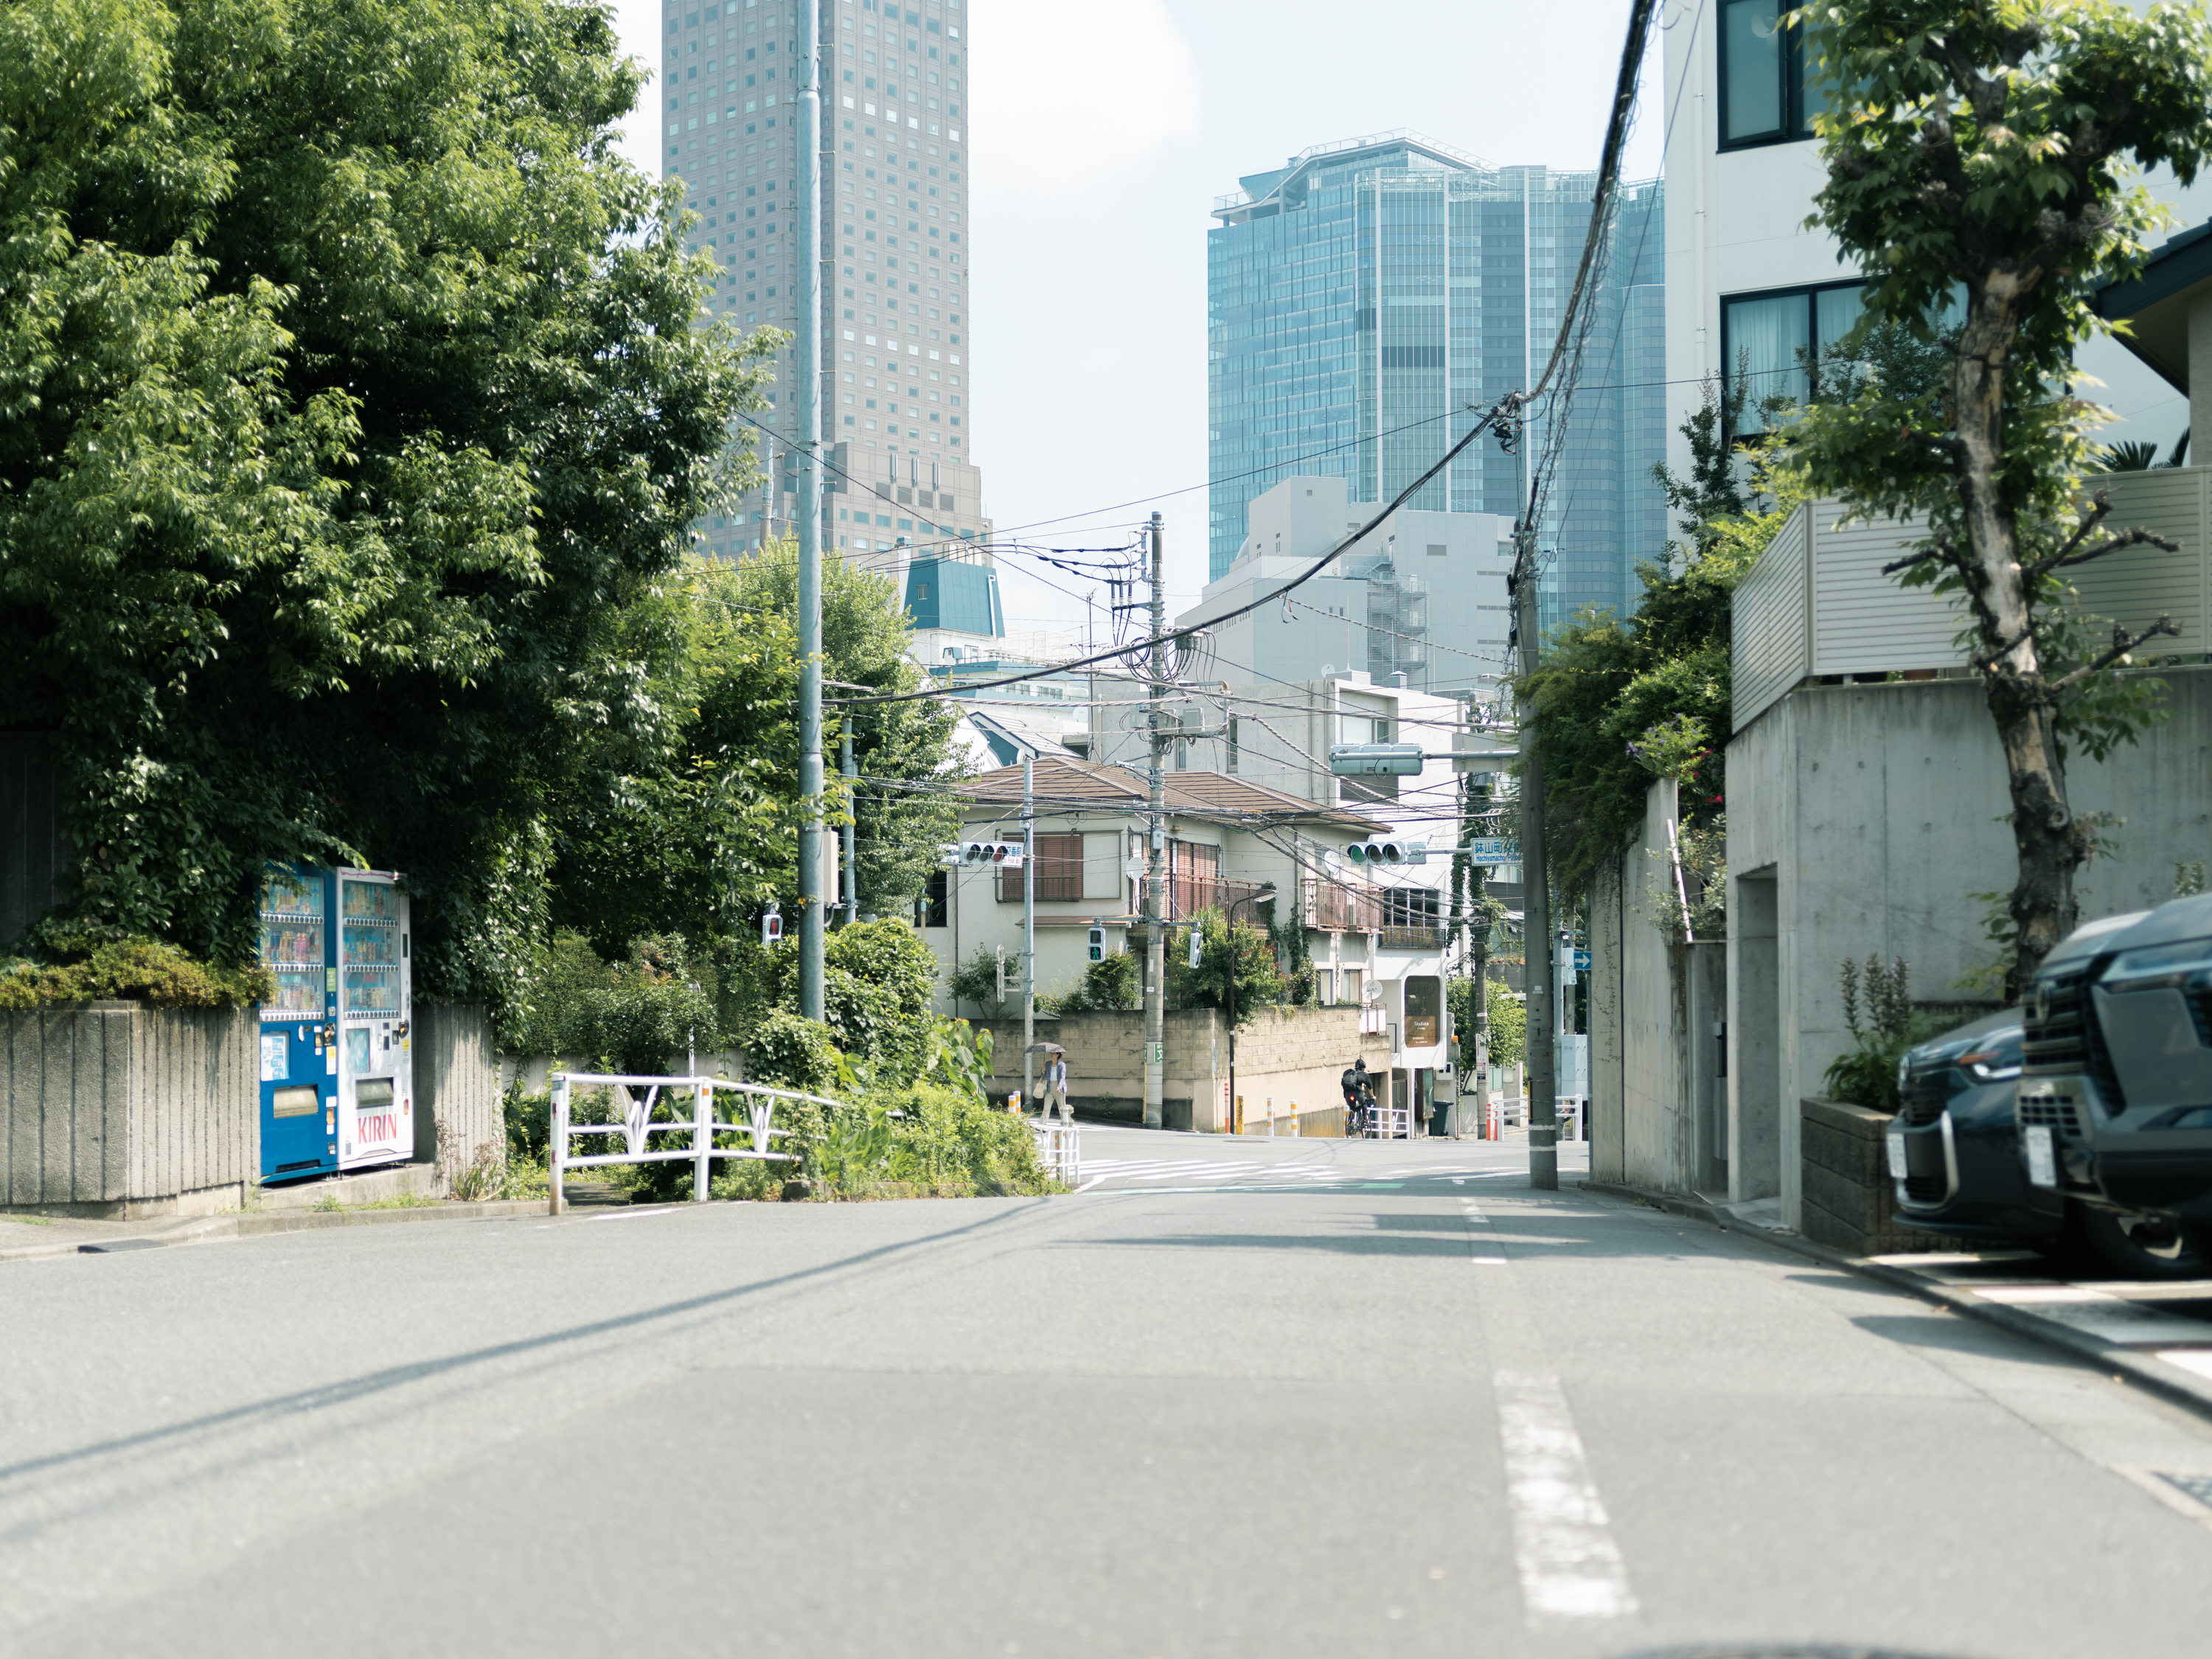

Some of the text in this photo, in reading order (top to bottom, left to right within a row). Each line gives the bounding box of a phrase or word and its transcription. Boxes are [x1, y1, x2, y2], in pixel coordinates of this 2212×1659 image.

[1476, 854, 1505, 863] Hachiyamacho
[281, 974, 302, 983] SUNTORY
[358, 1113, 397, 1145] KIRIN
